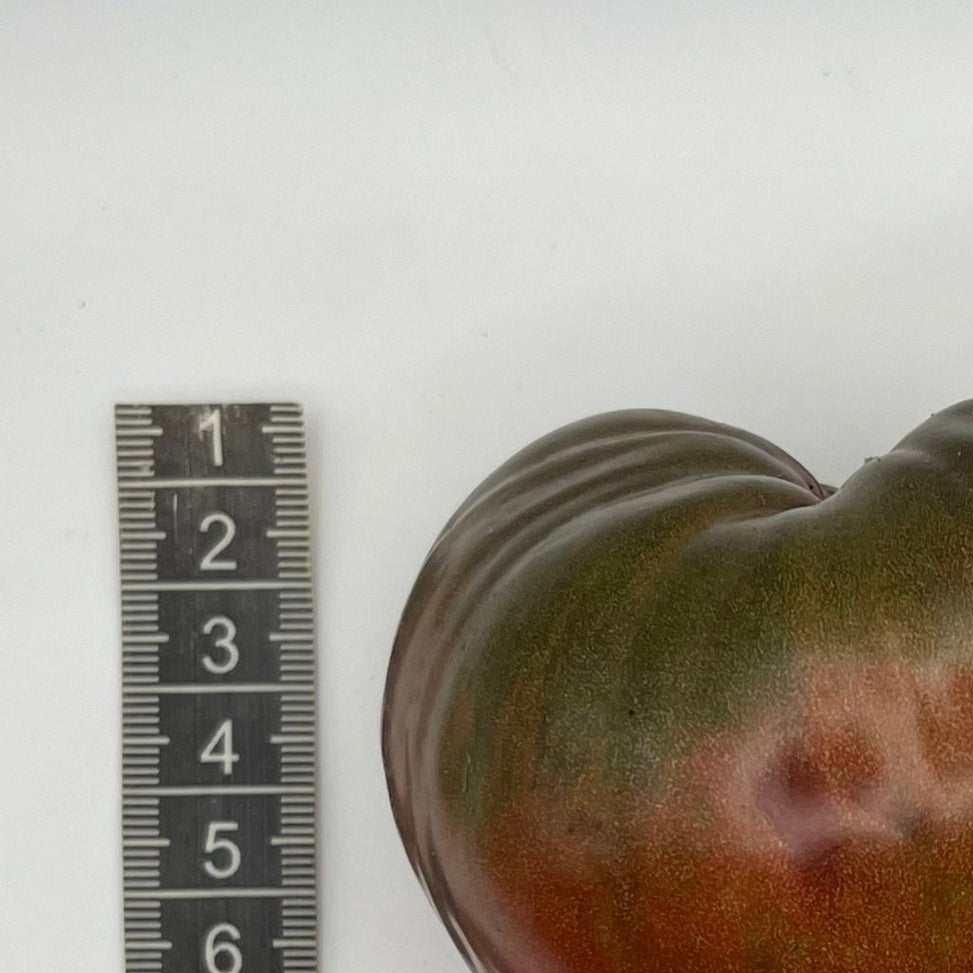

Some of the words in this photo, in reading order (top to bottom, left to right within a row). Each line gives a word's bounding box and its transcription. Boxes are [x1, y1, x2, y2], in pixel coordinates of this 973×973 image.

[199, 409, 223, 466] 1
[199, 512, 237, 571] 2
[202, 616, 239, 674] 3
[200, 719, 240, 775] 4
[203, 821, 241, 879] 5
